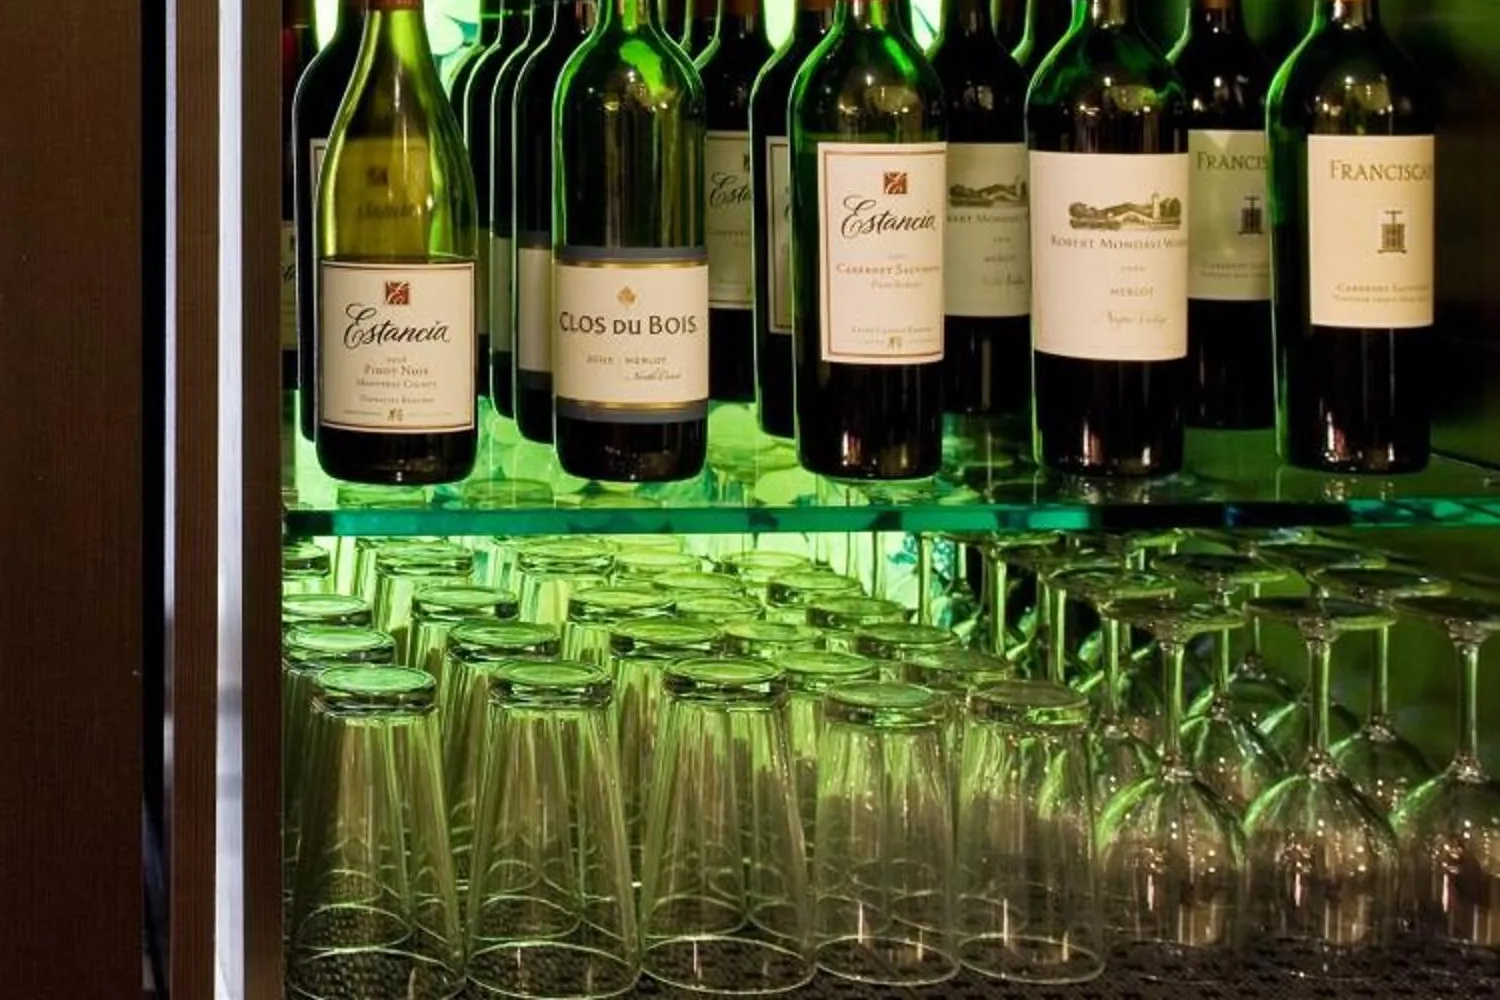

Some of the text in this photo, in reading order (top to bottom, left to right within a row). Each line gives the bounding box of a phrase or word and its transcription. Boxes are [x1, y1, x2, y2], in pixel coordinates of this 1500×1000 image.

[1197, 151, 1269, 172] FRANCIS
[1330, 159, 1431, 182] FRANCISC
[841, 193, 938, 240] Estancia
[343, 303, 452, 350] Estancia
[559, 311, 607, 334] CLOS
[649, 314, 698, 335] BOIS
